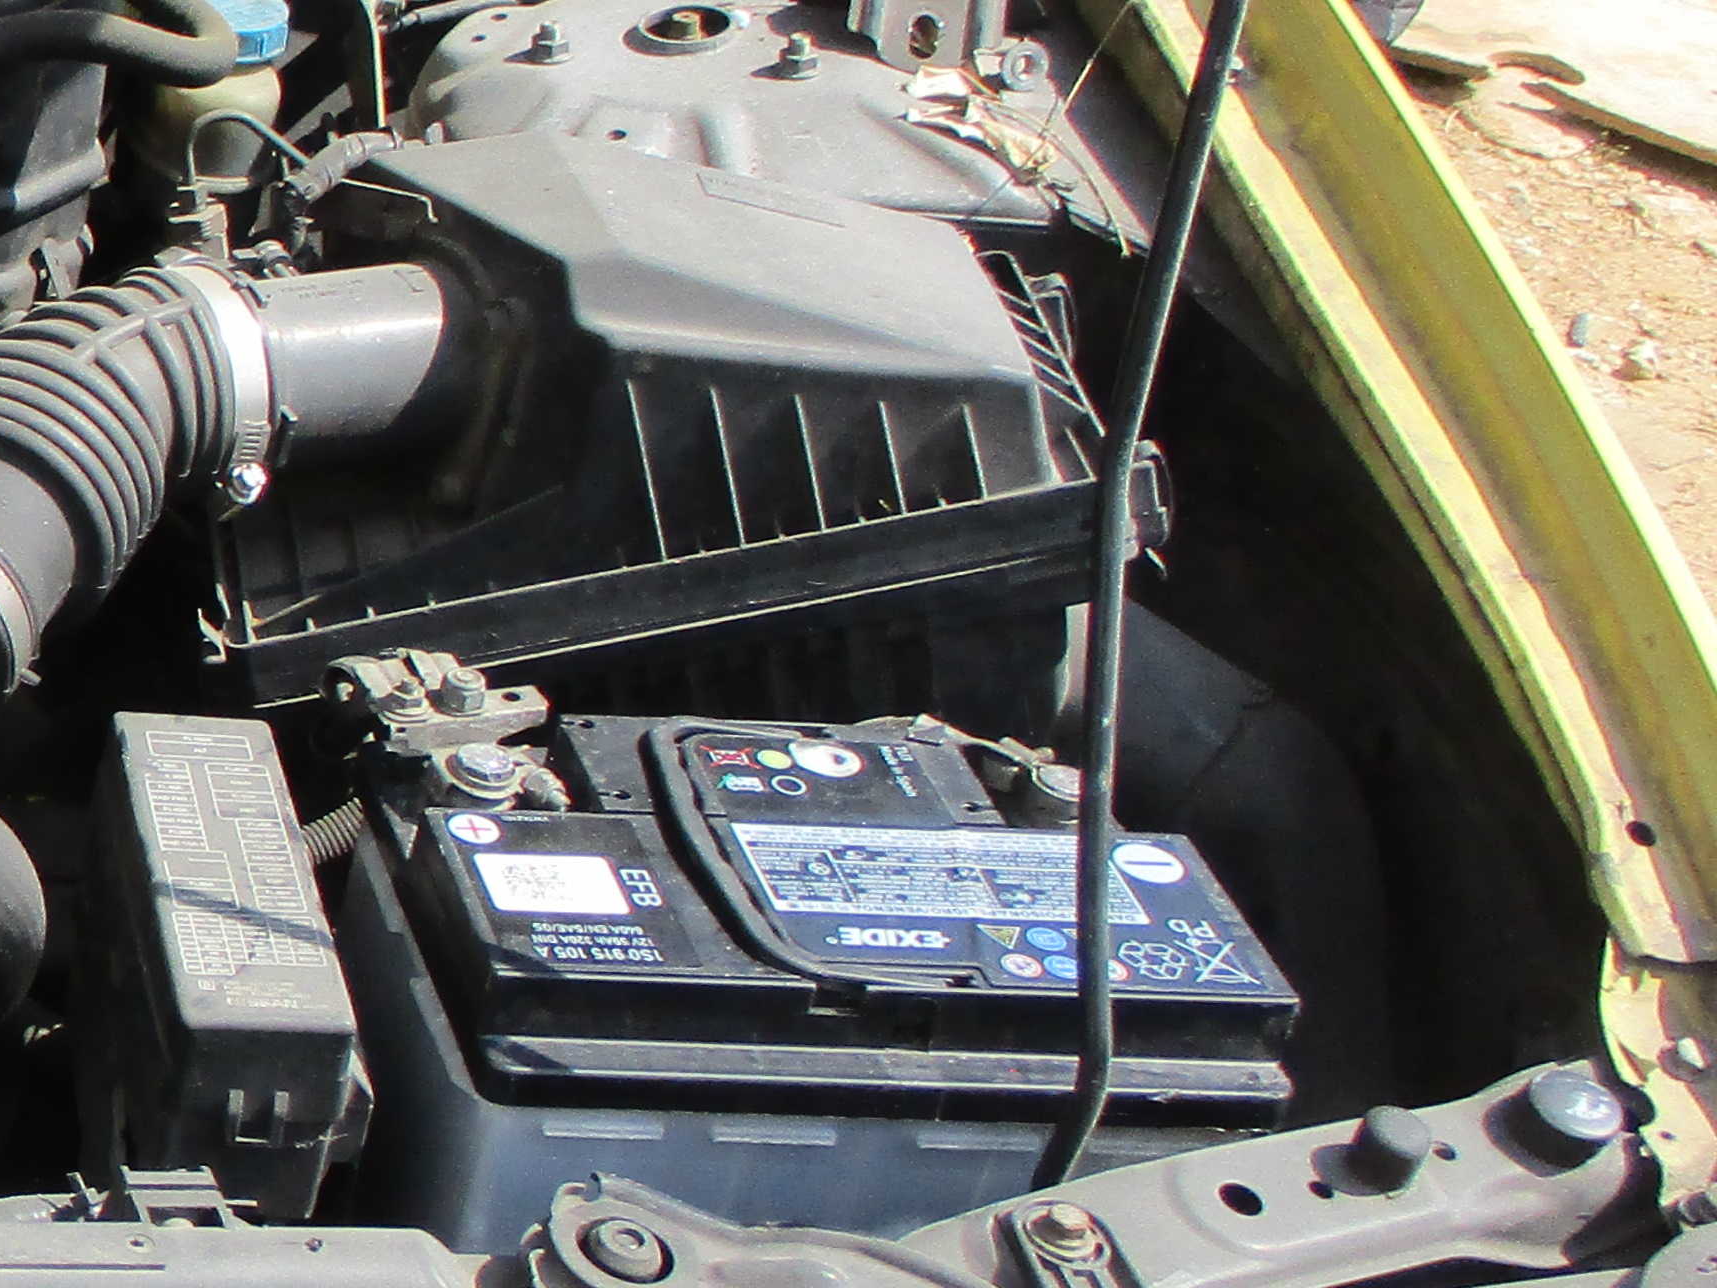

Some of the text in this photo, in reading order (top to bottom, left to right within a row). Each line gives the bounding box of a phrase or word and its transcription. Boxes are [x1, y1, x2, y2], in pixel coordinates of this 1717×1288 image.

[618, 868, 663, 908] EFB
[1166, 917, 1220, 939] Pb
[532, 933, 557, 944] DIN
[630, 937, 654, 946] 12V
[837, 926, 950, 948] EXIDE
[534, 945, 550, 957] A
[554, 946, 587, 959] 105
[591, 947, 623, 961] 915
